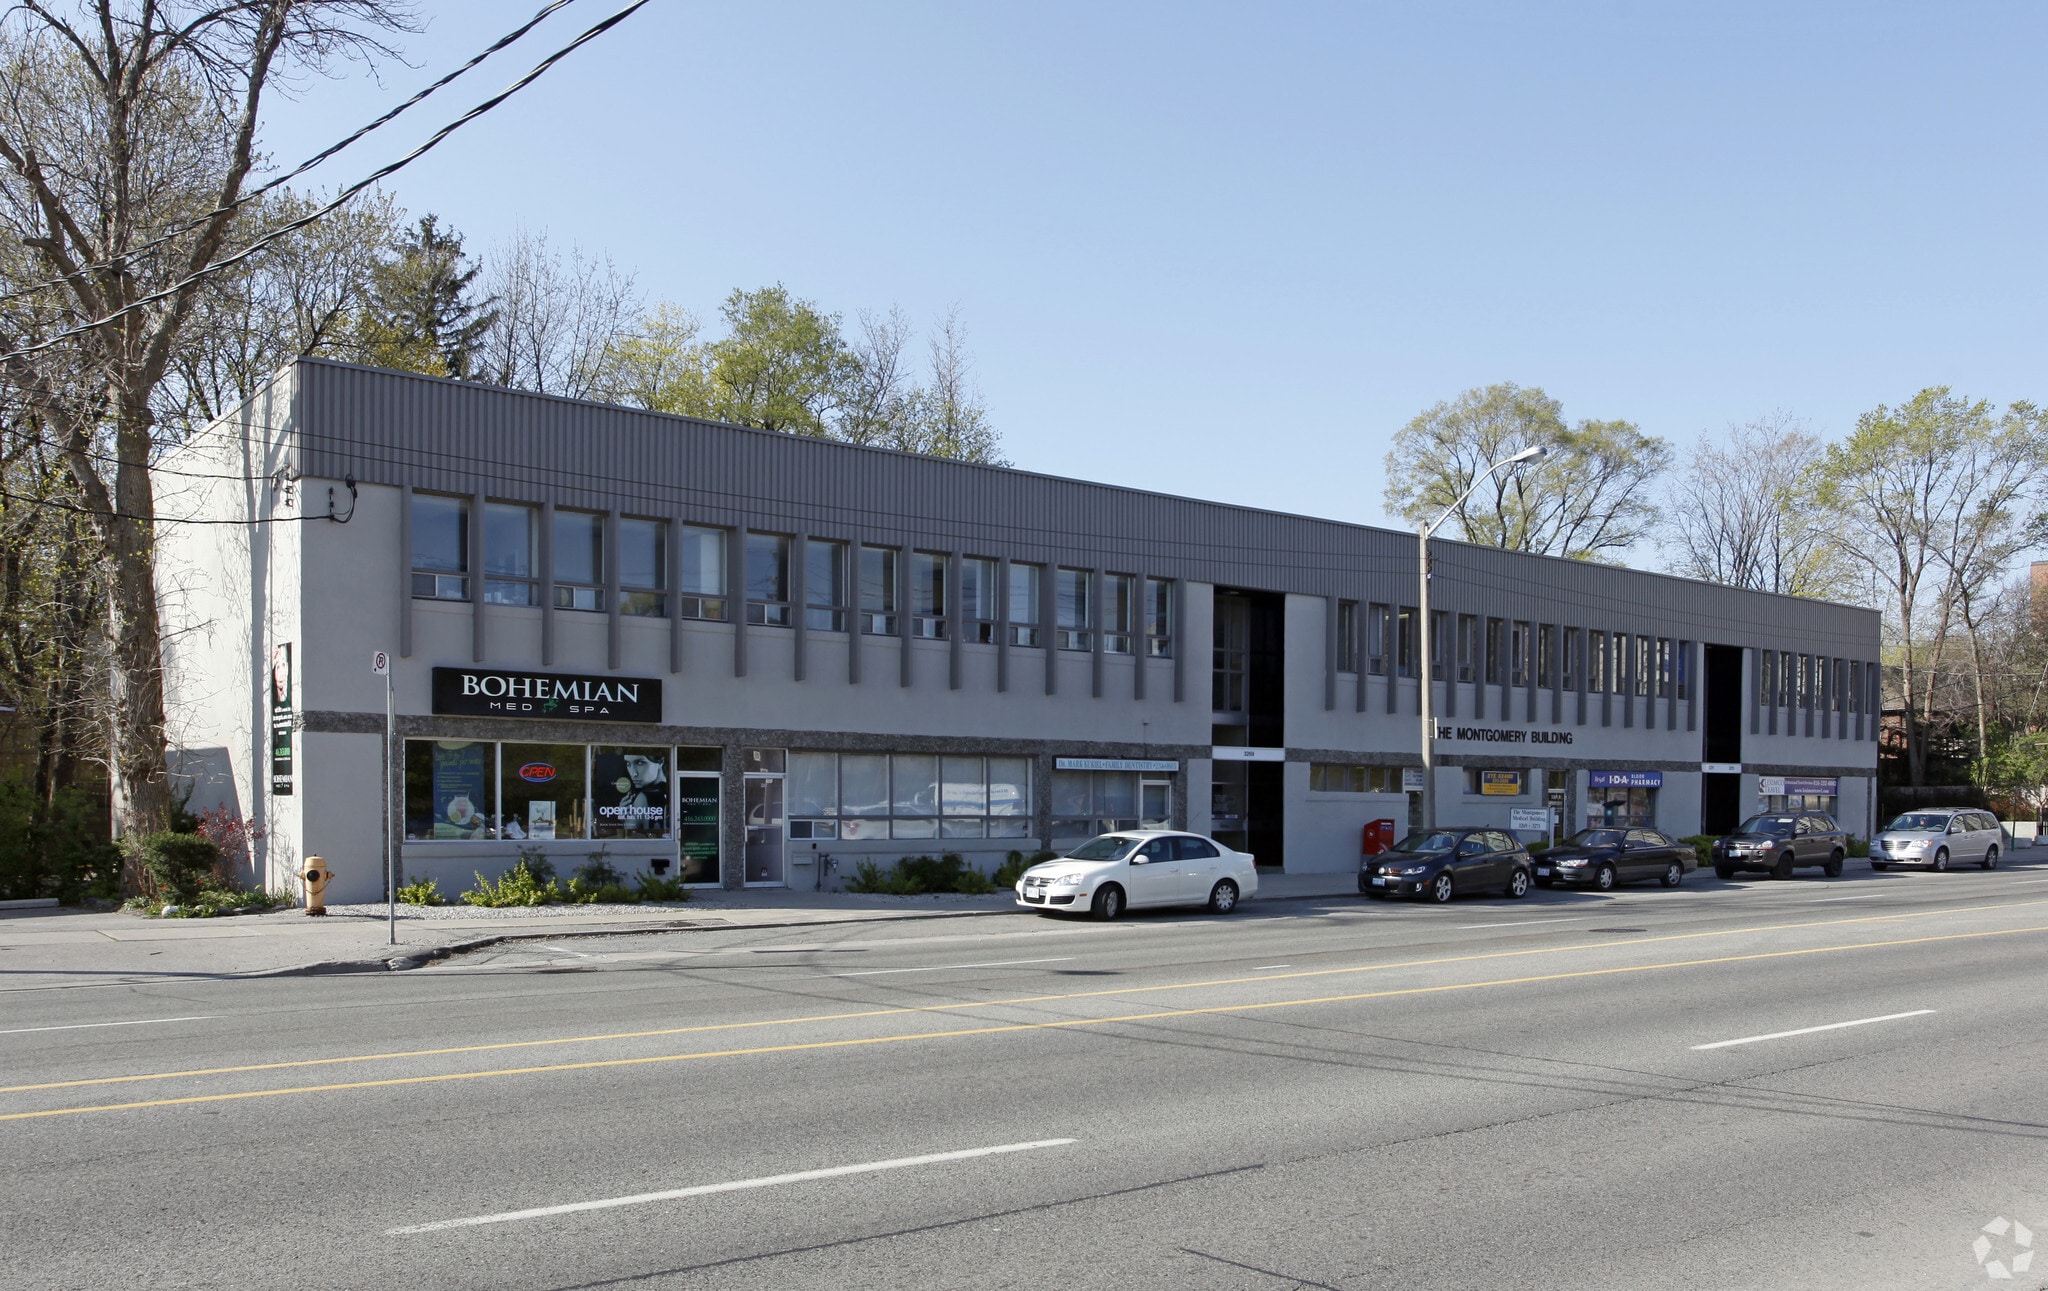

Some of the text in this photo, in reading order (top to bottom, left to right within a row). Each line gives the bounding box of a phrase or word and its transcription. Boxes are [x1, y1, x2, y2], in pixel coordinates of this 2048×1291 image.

[461, 674, 639, 704] BOHEMIAN
[490, 702, 609, 714] MED SPA
[1457, 727, 1527, 743] MONTGOMERY
[1531, 731, 1573, 744] BUILDING
[521, 766, 556, 778] OPEN
[599, 804, 663, 818] open house
